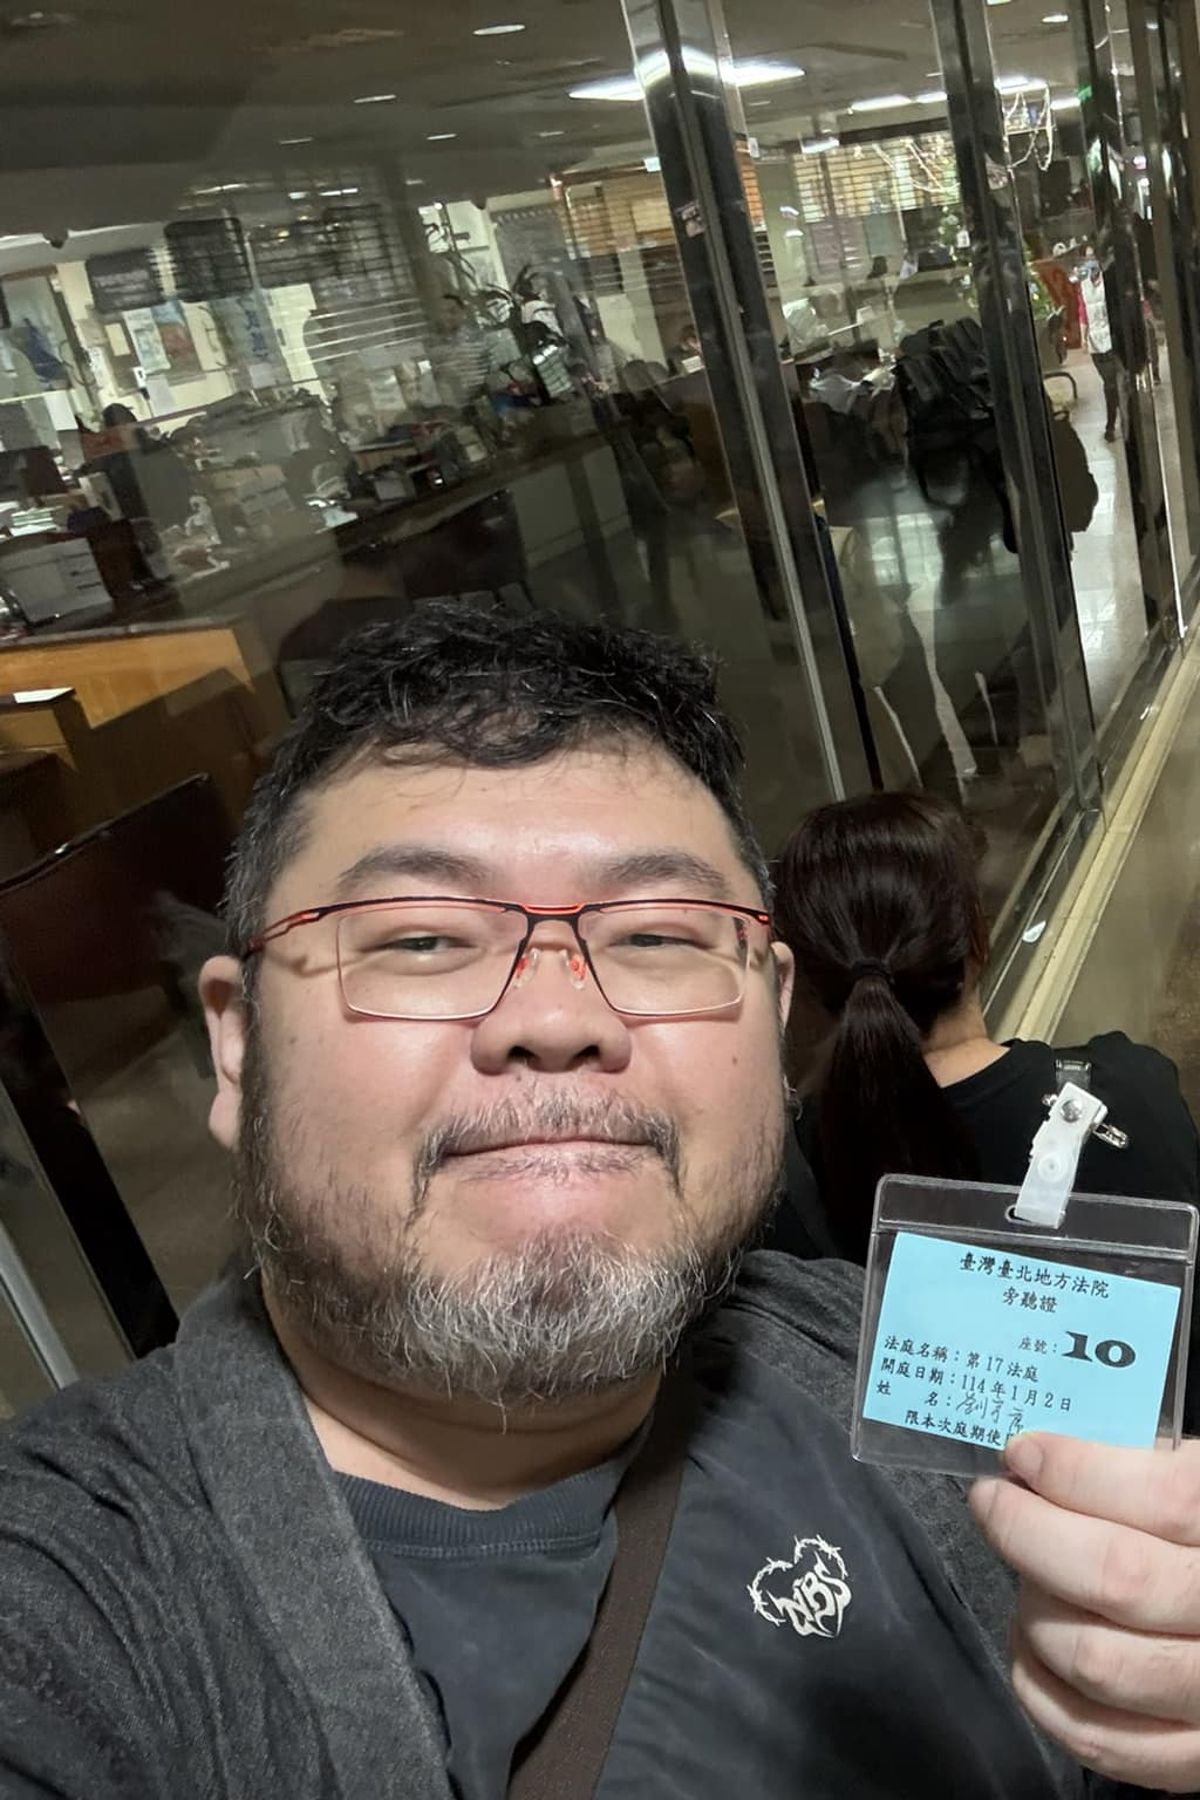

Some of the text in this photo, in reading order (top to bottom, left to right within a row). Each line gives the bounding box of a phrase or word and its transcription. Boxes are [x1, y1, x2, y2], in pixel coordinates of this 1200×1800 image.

[960, 1252, 1110, 1299] 臺灣臺北地方法院
[1003, 1286, 1058, 1314] 旁聽證
[1062, 1330, 1137, 1369] 10
